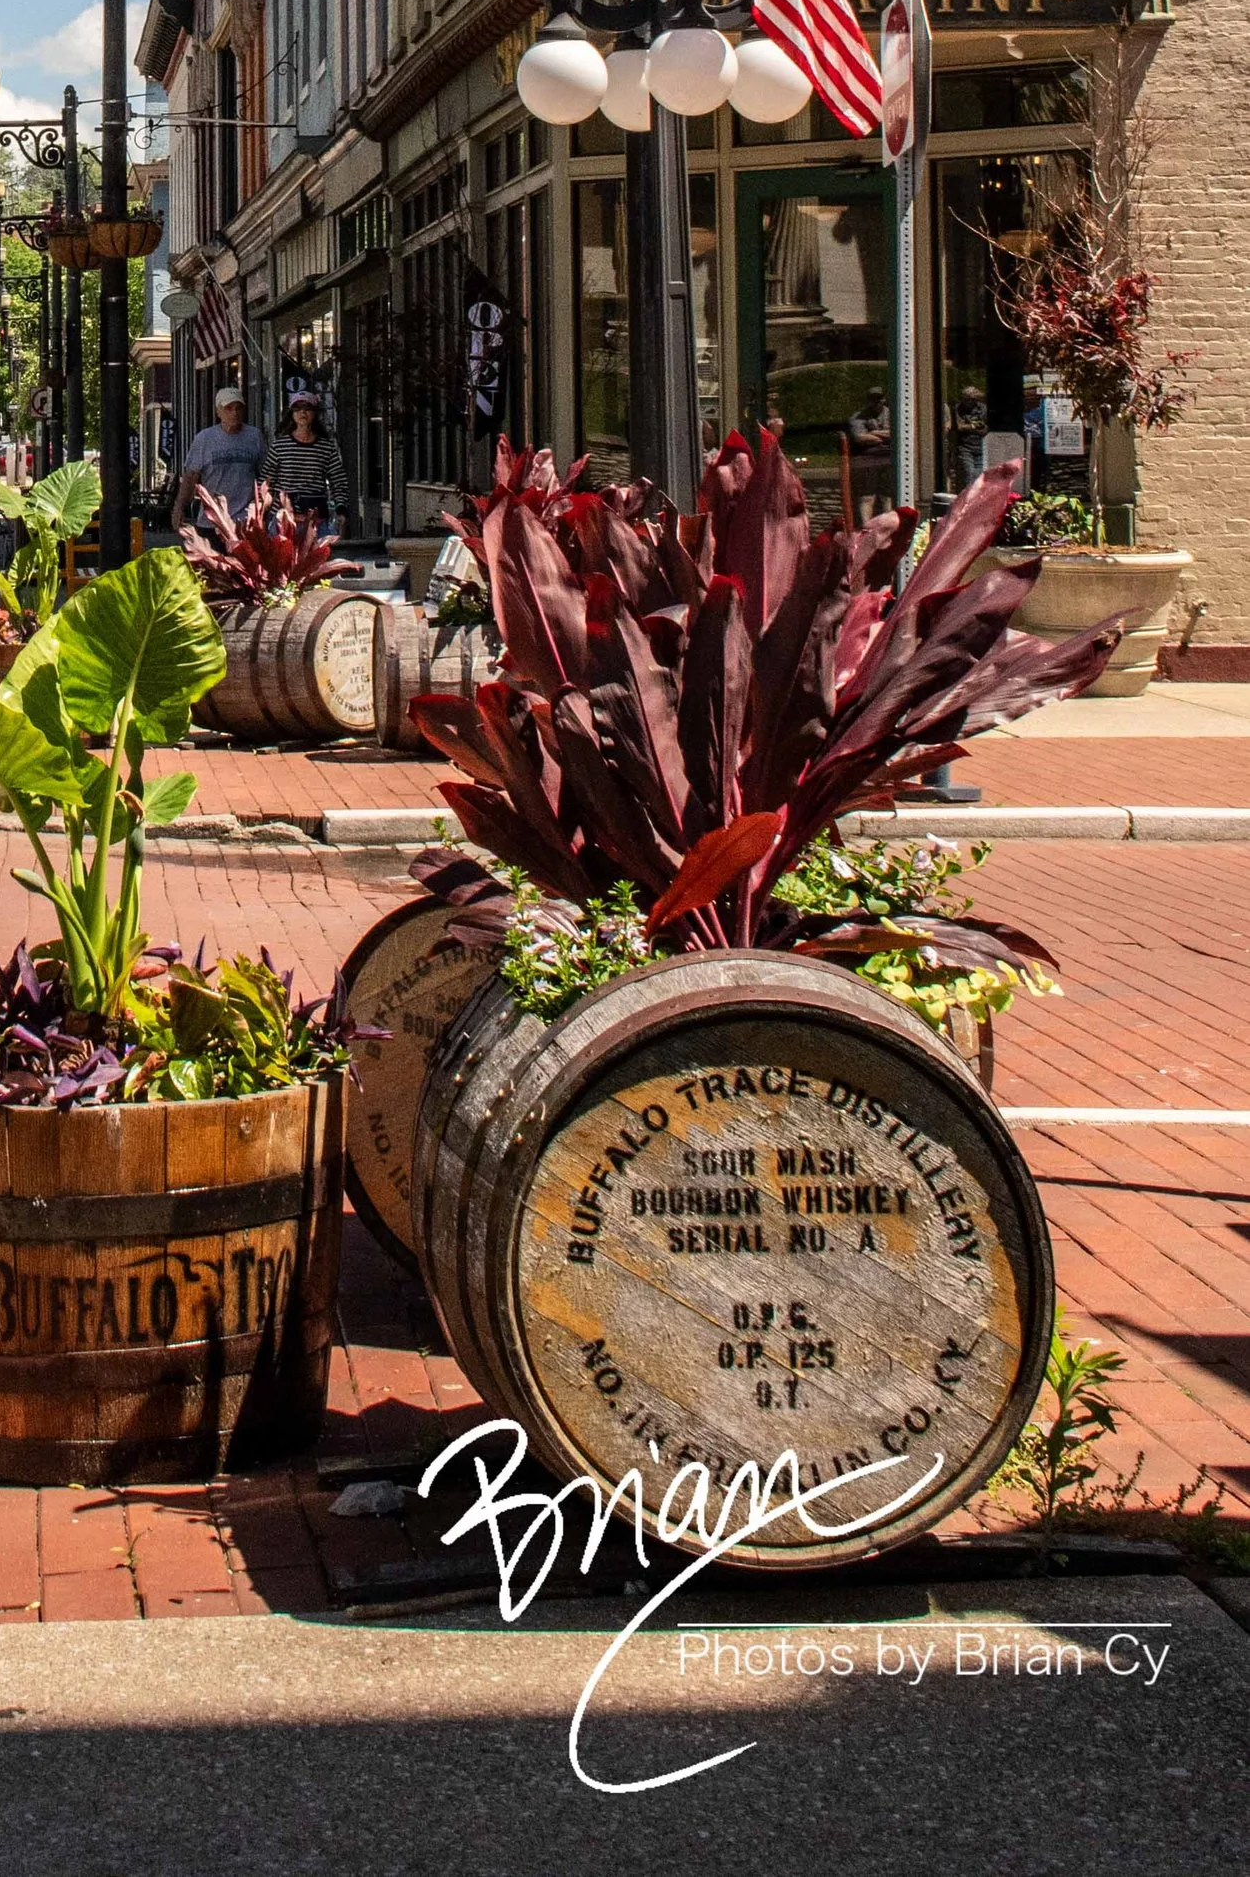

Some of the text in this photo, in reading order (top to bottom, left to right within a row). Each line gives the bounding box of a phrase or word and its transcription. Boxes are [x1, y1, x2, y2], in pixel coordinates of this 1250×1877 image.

[468, 301, 504, 416] OPEN
[344, 701, 372, 713] FRANKL
[566, 1067, 982, 1264] BUFFALO TRACE DISTILLERY
[683, 1146, 856, 1177] SOUR MASH
[631, 1185, 910, 1216] BOURBON WHISKEY
[668, 1224, 878, 1254] SERIAL NO. A
[788, 1338, 836, 1369] 125
[880, 1402, 944, 1455] CO.
